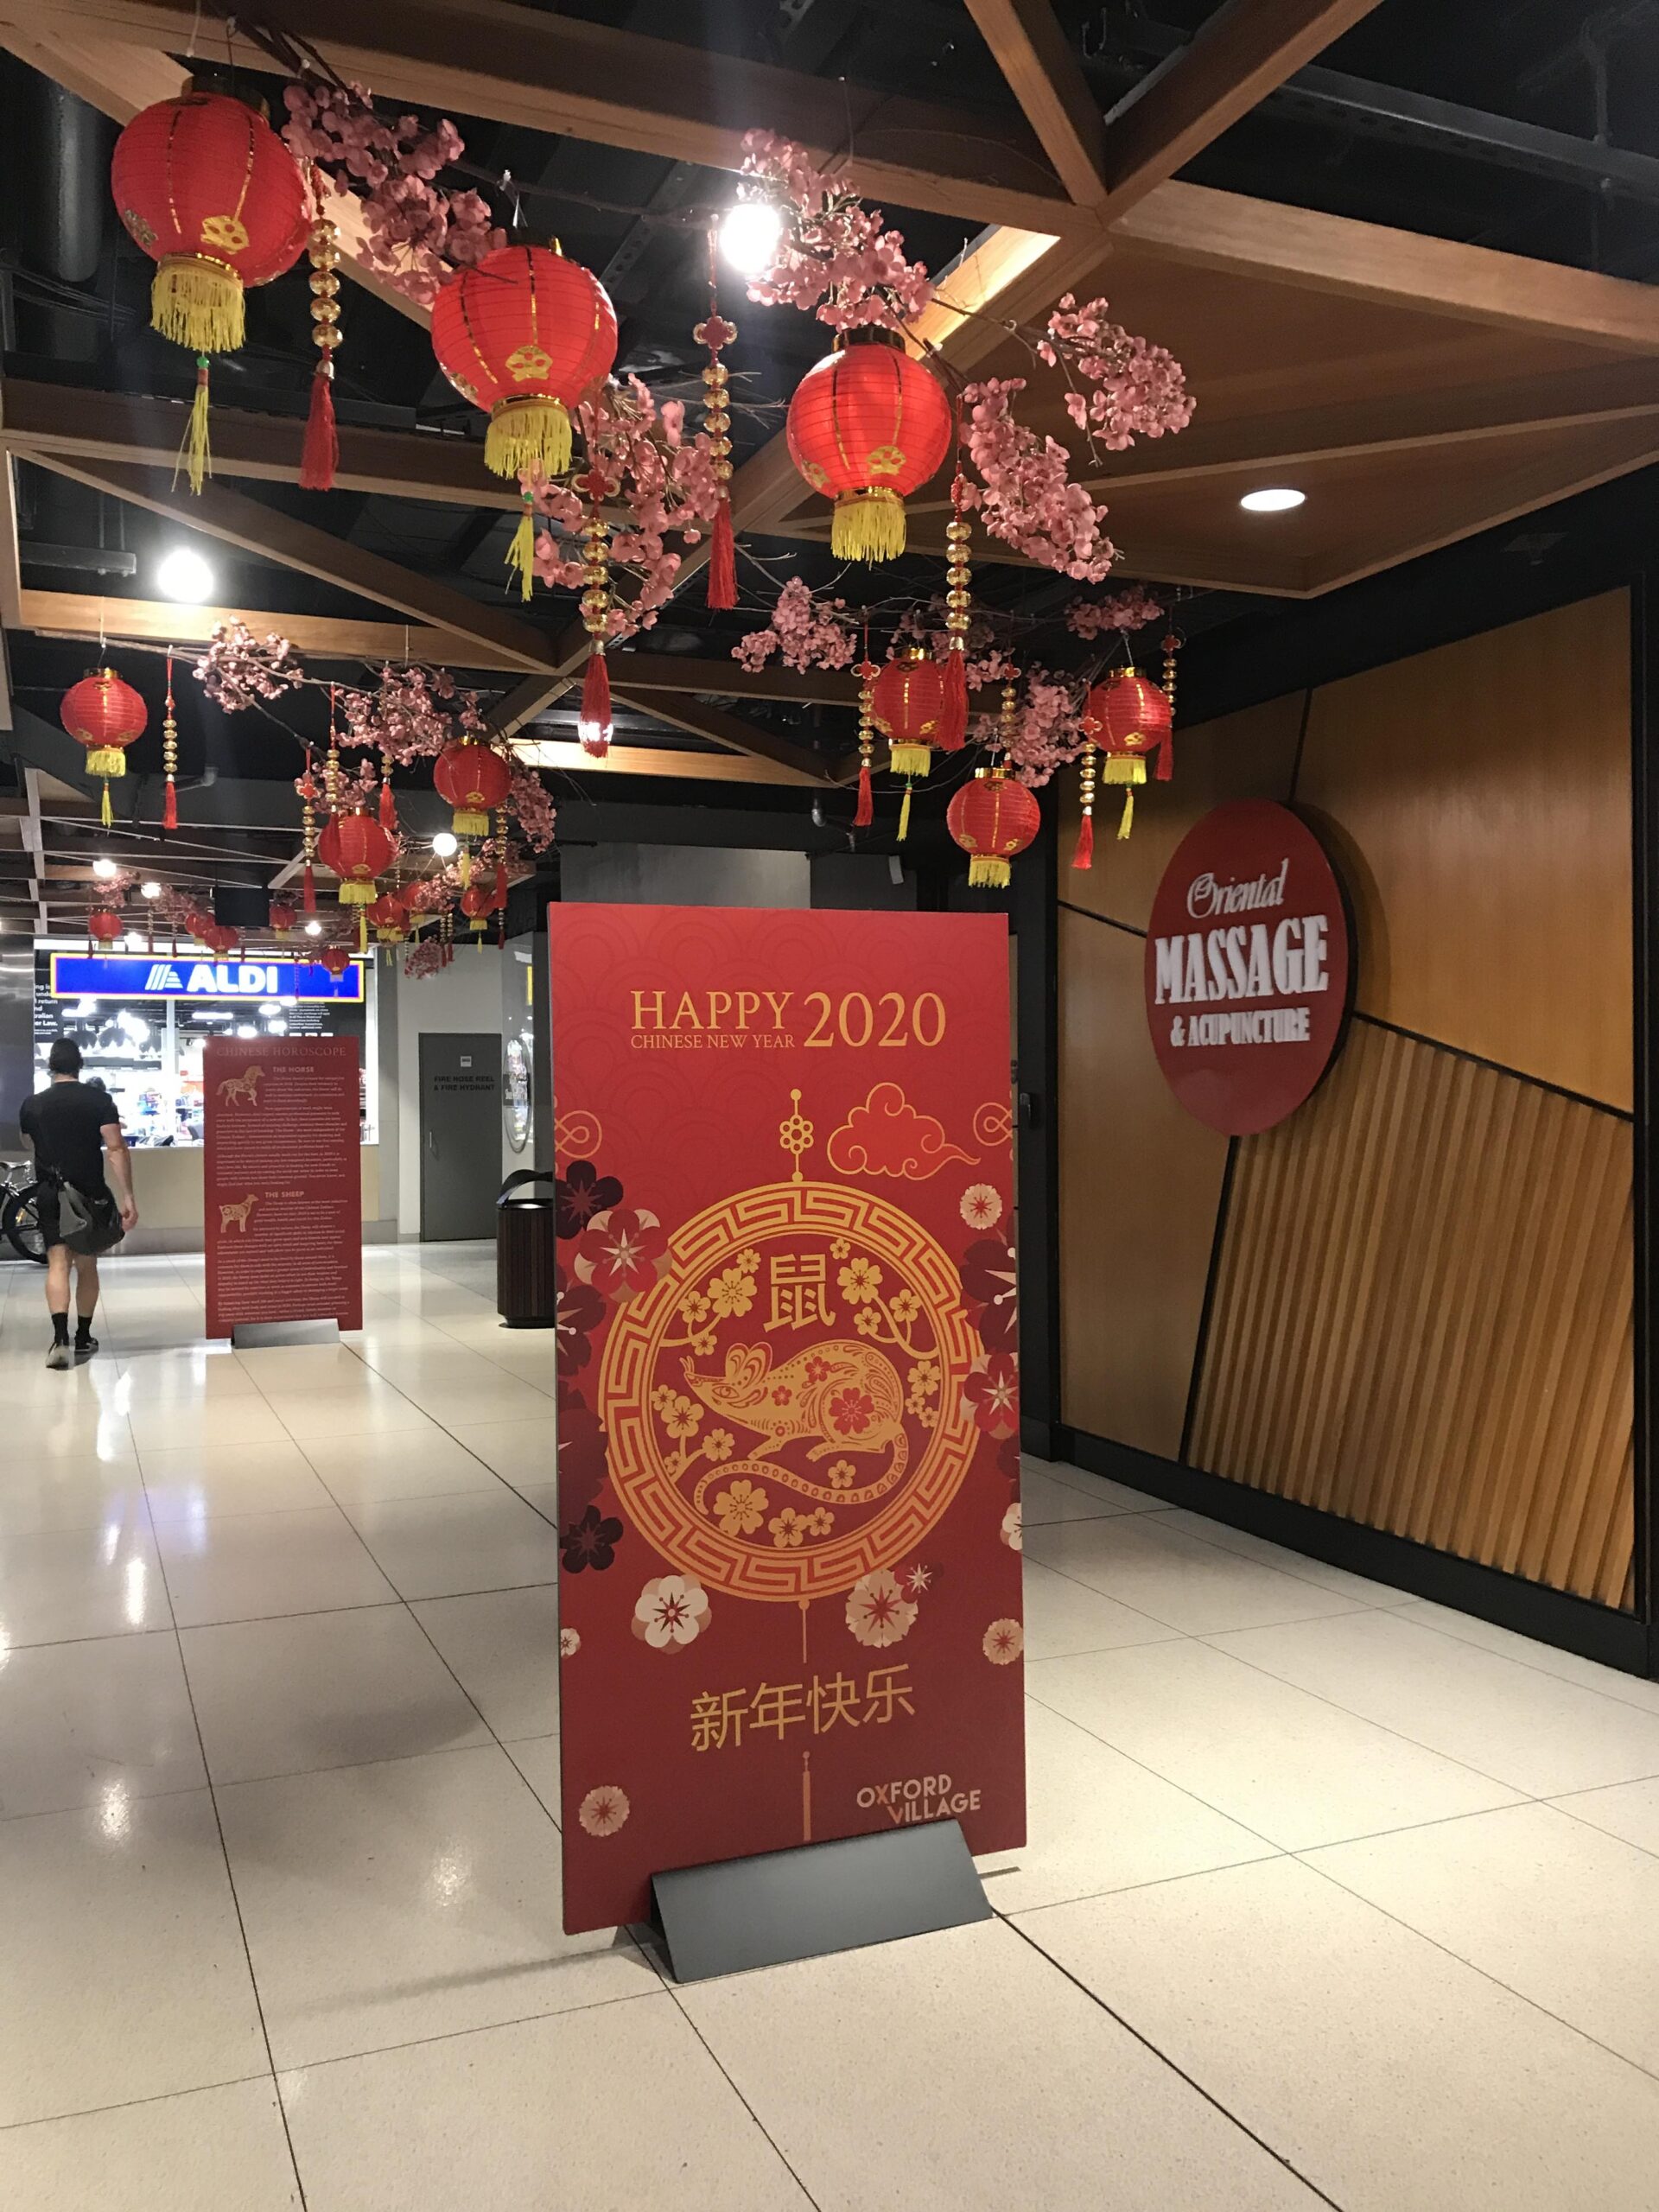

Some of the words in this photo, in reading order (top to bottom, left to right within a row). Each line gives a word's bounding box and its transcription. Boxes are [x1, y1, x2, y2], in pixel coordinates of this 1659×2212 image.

[1187, 857, 1289, 918] Oriental
[186, 963, 278, 994] ALDI
[1154, 914, 1329, 1004] MASSAGE
[630, 990, 795, 1029] HAPPY
[804, 992, 946, 1047] 2020
[1170, 1015, 1185, 1047] &
[1187, 1007, 1310, 1046] ACUPUNCTURE
[216, 1046, 270, 1057] CHINESE
[273, 1046, 346, 1057] HOROSCOPE
[631, 1034, 702, 1049] CHINESE
[707, 1034, 748, 1049] NEW
[753, 1034, 795, 1048] YEAR
[763, 1253, 836, 1332] 鼠
[690, 1663, 915, 1752] 新年快乐
[856, 1773, 952, 1808] OXFORD
[887, 1789, 982, 1824] VILLAGE
